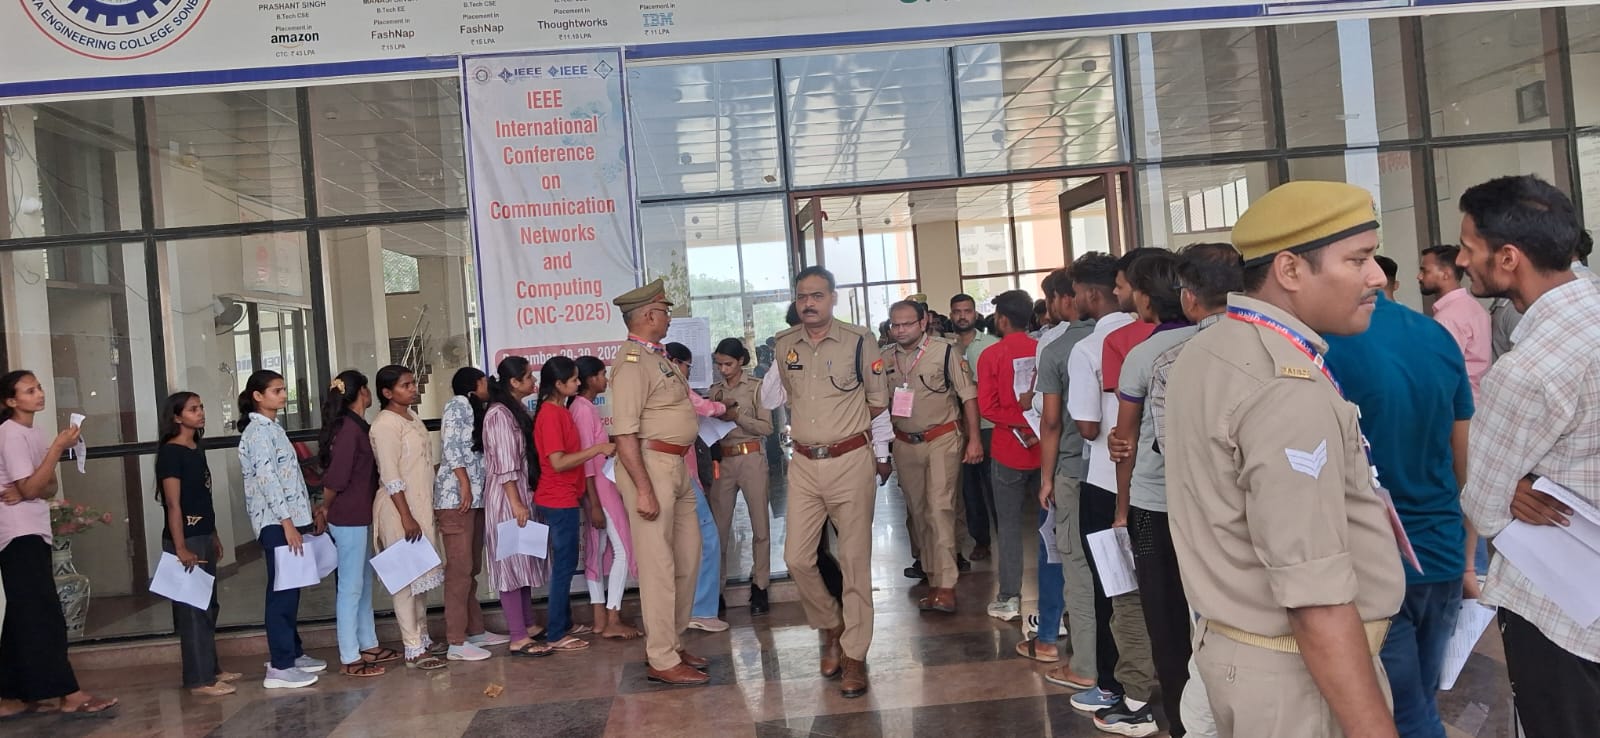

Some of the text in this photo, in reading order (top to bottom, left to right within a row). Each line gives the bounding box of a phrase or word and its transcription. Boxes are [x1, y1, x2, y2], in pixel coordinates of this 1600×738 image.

[258, 0, 327, 11] PRASHANT SINGH
[537, 18, 608, 31] Thoughtworks
[642, 12, 675, 27] IBM
[41, 9, 116, 50] ENGINEERING
[119, 23, 175, 50] COLLEGE
[372, 29, 415, 40] FashNap
[460, 23, 504, 34] FashNap
[271, 32, 319, 44] amazon
[514, 67, 542, 76] IEEE
[560, 65, 588, 75] IEEE
[527, 89, 563, 109] IEEE
[495, 115, 598, 138] International
[503, 145, 595, 165] Conference
[541, 174, 561, 190] on
[490, 198, 616, 220] Communication
[520, 225, 596, 245] Networks
[543, 251, 572, 270] and
[516, 278, 603, 300] Computing
[517, 302, 611, 329] (CNC-2025)
